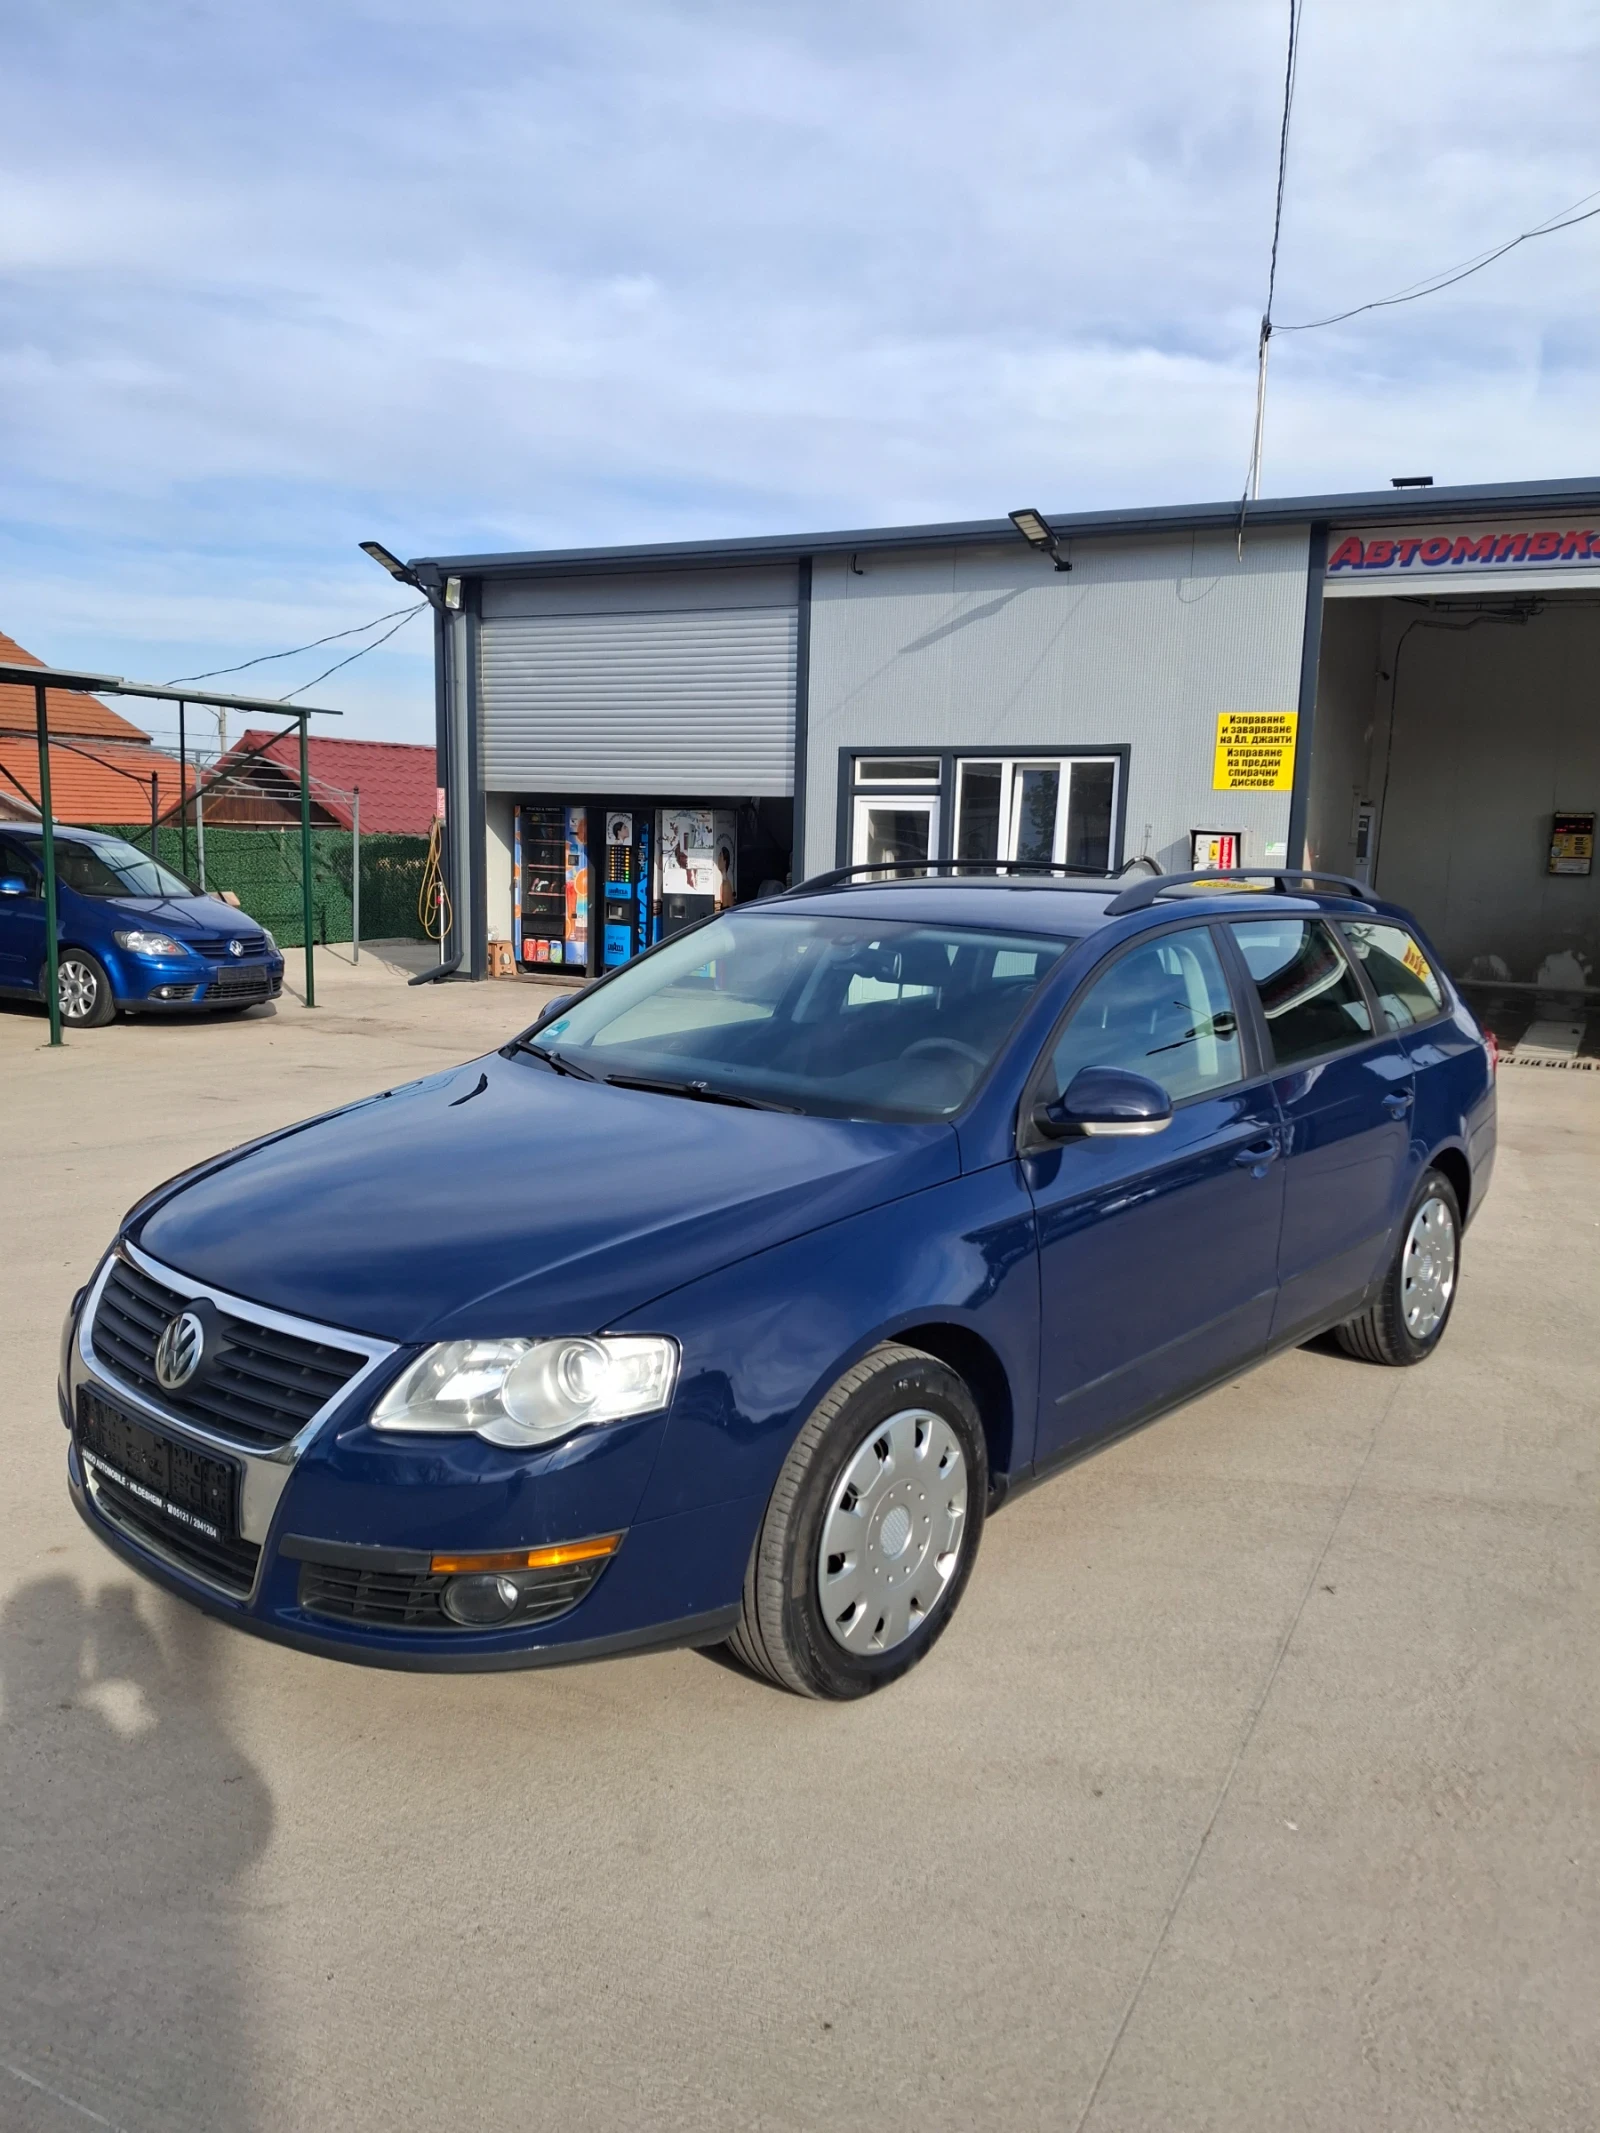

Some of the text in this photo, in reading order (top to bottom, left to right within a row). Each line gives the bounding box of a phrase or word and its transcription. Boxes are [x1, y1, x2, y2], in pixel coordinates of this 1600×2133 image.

[1229, 715, 1286, 725] Изправяне
[1222, 725, 1292, 734] и заваряване
[1220, 735, 1292, 745] на Ал. джанти
[1227, 748, 1283, 758] Изправяне
[1227, 759, 1281, 768] на предни
[1228, 768, 1279, 777] спирачни
[1230, 778, 1275, 788] дискове
[96, 1459, 126, 1486] AUTOMOBILE
[129, 1481, 162, 1508] HILDESHEIM
[172, 1507, 189, 1523] 05121
